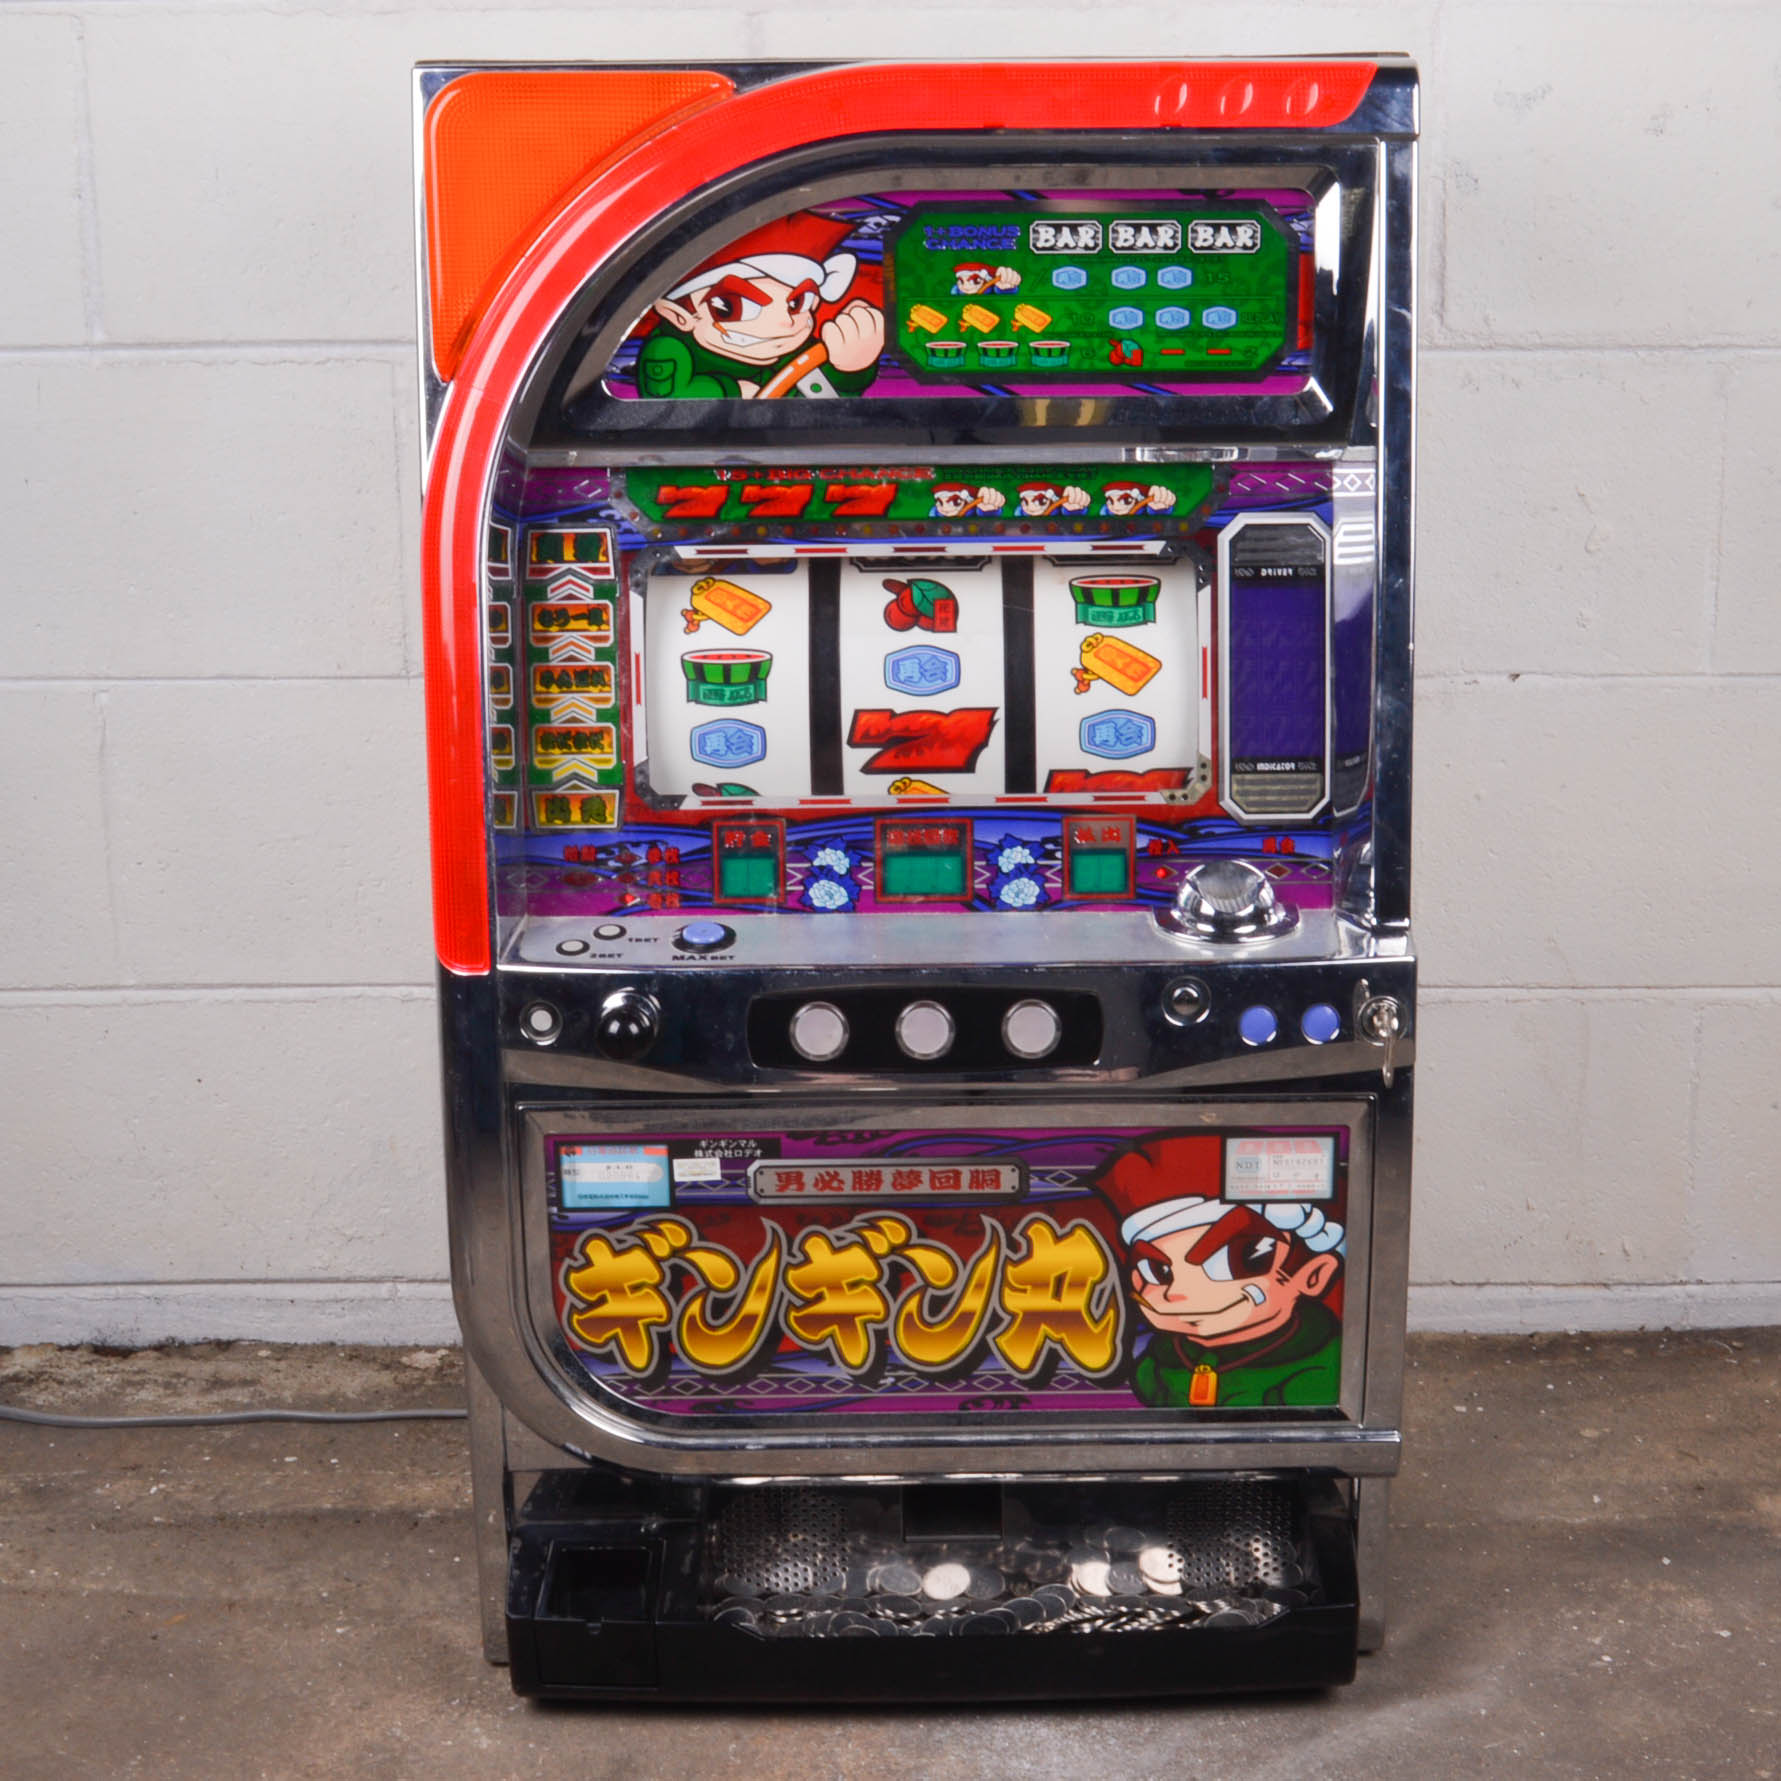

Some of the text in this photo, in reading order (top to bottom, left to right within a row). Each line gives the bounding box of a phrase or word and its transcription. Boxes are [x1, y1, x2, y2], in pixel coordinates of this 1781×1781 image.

[1036, 224, 1257, 248] BAR BAR BAR
[694, 1148, 762, 1158] 株式会社ロデオ
[699, 1139, 757, 1148] ギンギンマル
[775, 1168, 1003, 1193] 男必勝夢回胴
[560, 1212, 1126, 1377] ギンギン丸
